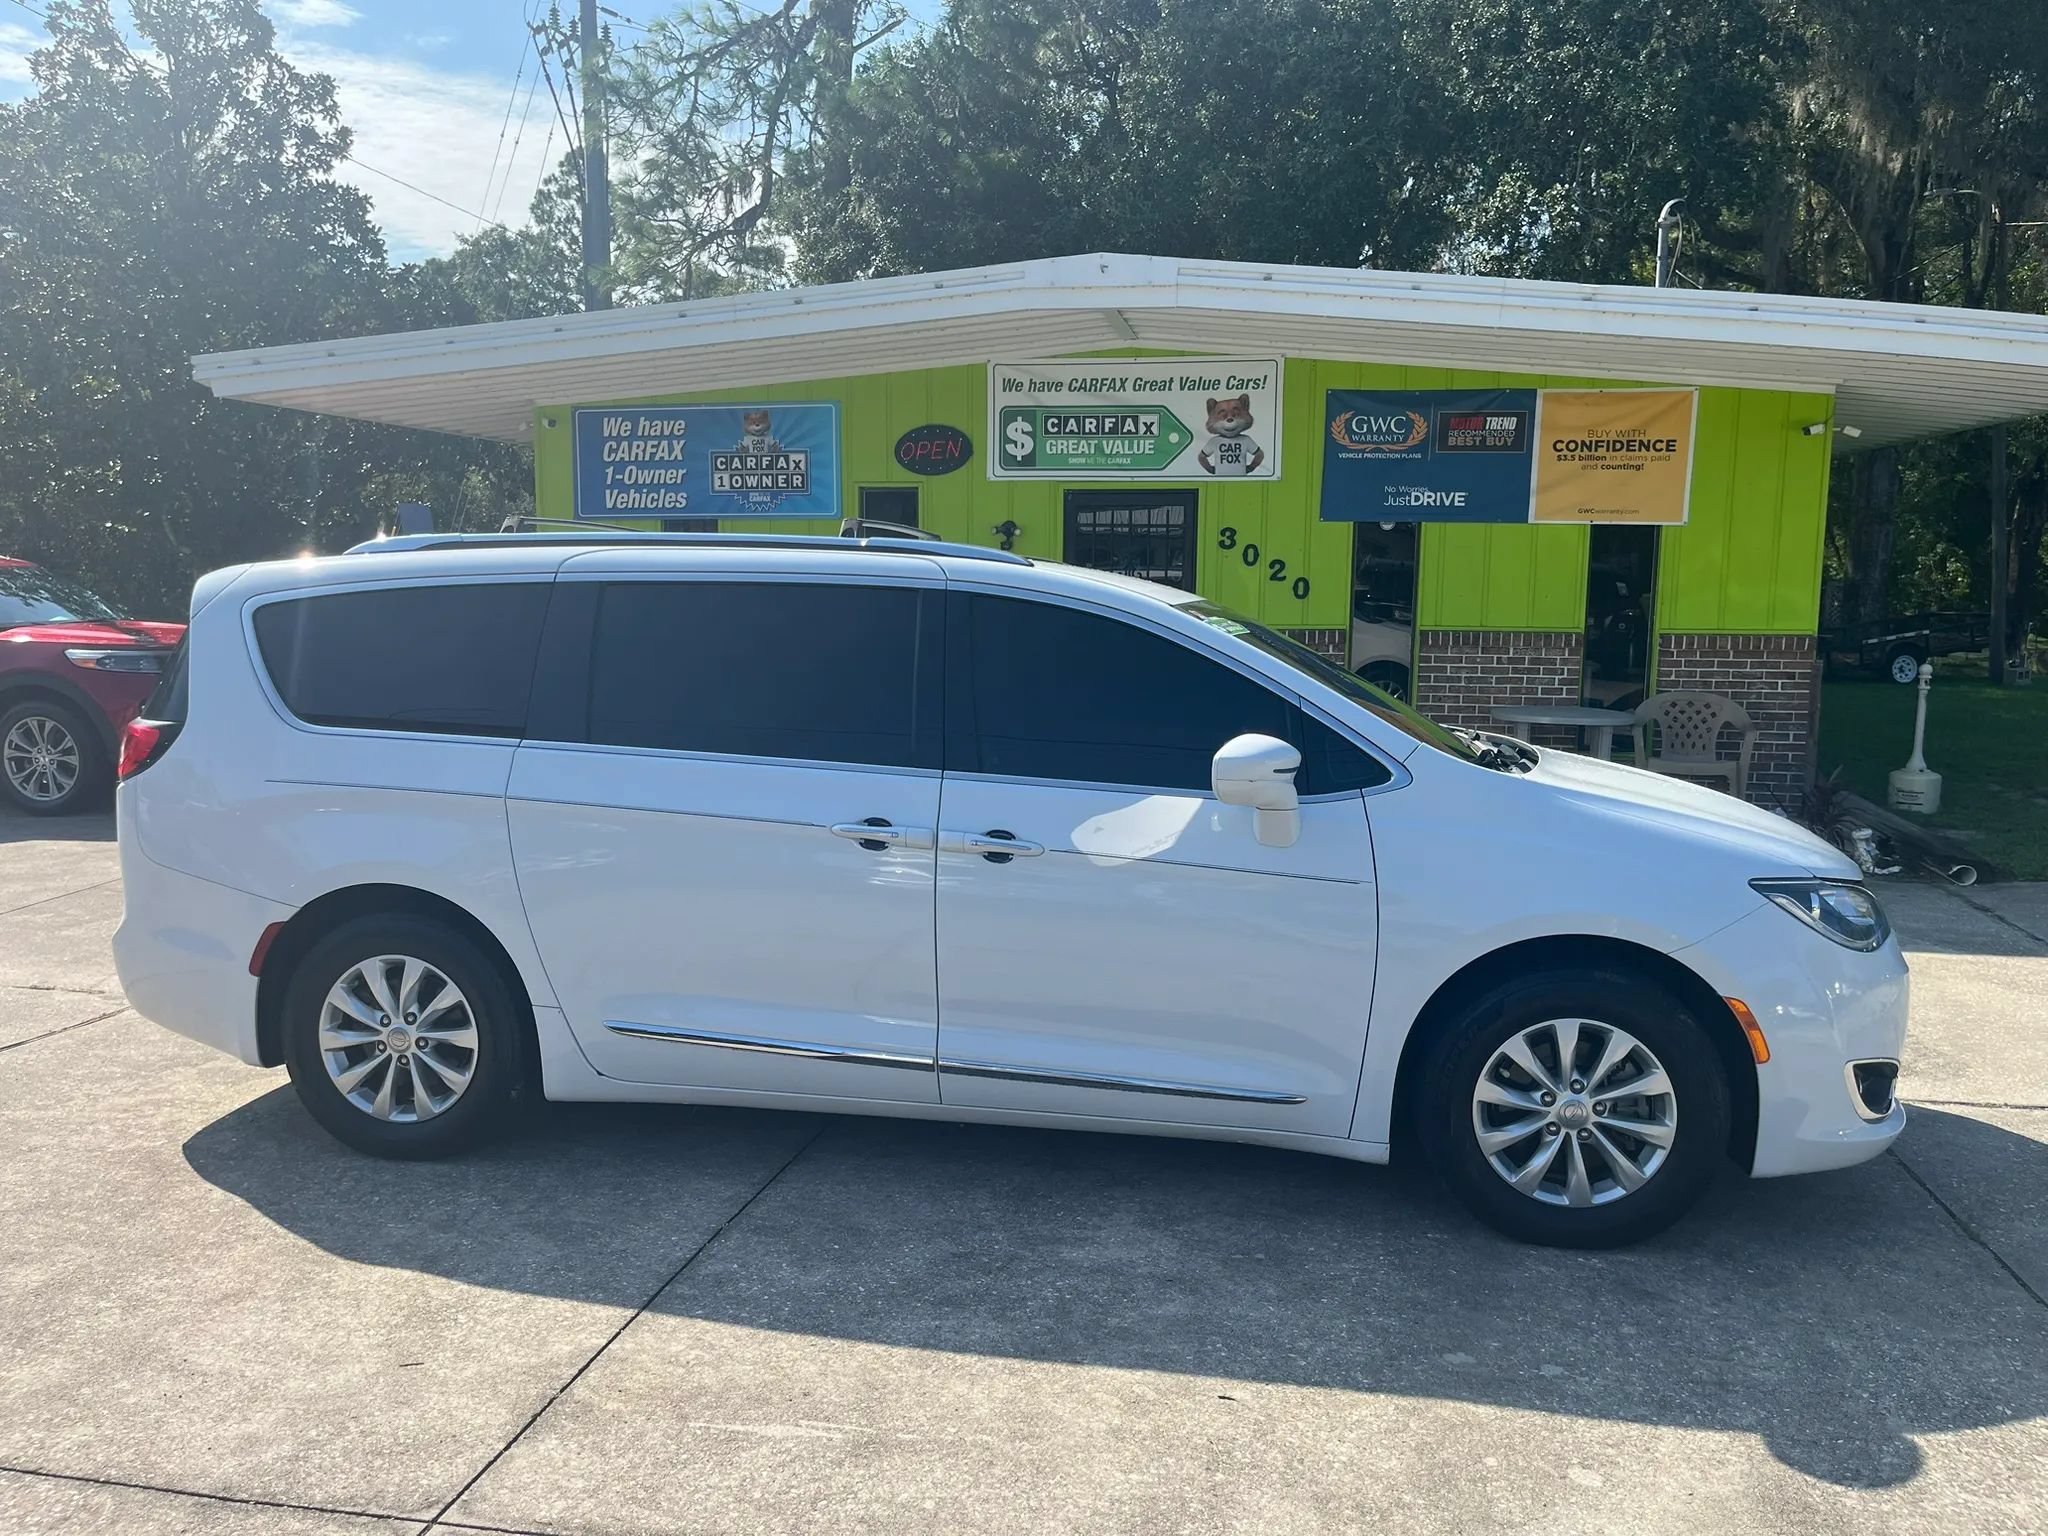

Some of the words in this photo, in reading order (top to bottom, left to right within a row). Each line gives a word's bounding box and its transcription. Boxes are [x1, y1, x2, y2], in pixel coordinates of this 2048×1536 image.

[1001, 378, 1024, 393] We
[1028, 378, 1063, 393] have
[1067, 377, 1128, 393] CARFAX
[1132, 377, 1174, 392] Great
[1178, 375, 1220, 391] Value
[1225, 374, 1268, 391] Cars!
[603, 416, 632, 438] We
[637, 416, 686, 437] have
[1046, 416, 1158, 436] CARFAX
[1351, 415, 1406, 434] GWC
[1485, 416, 1518, 430] TREND
[1351, 434, 1405, 443] WARRANTY
[1448, 430, 1516, 438] RECOMMENDED
[1587, 429, 1611, 438] BUY
[1615, 429, 1646, 438] WITH
[1046, 439, 1098, 456] GREAT
[1102, 439, 1156, 456] VALUE
[1219, 443, 1242, 453] CAR
[1447, 437, 1482, 446] BEST
[1486, 437, 1515, 446] BUY
[1552, 439, 1678, 453] CONFIDENCE
[602, 439, 687, 463] CARFAX
[900, 439, 962, 461] OPEN
[715, 454, 804, 472] CARFAX
[1220, 454, 1241, 464] FOX
[1556, 454, 1576, 462] $3.5
[1578, 454, 1607, 462] billion
[1650, 454, 1671, 463] paid
[1600, 463, 1645, 471] counting!
[604, 465, 688, 486] 1-Owner
[716, 473, 727, 489] 1
[731, 473, 804, 488] OWNER
[1384, 485, 1397, 493] No
[604, 489, 689, 510] Vehicles
